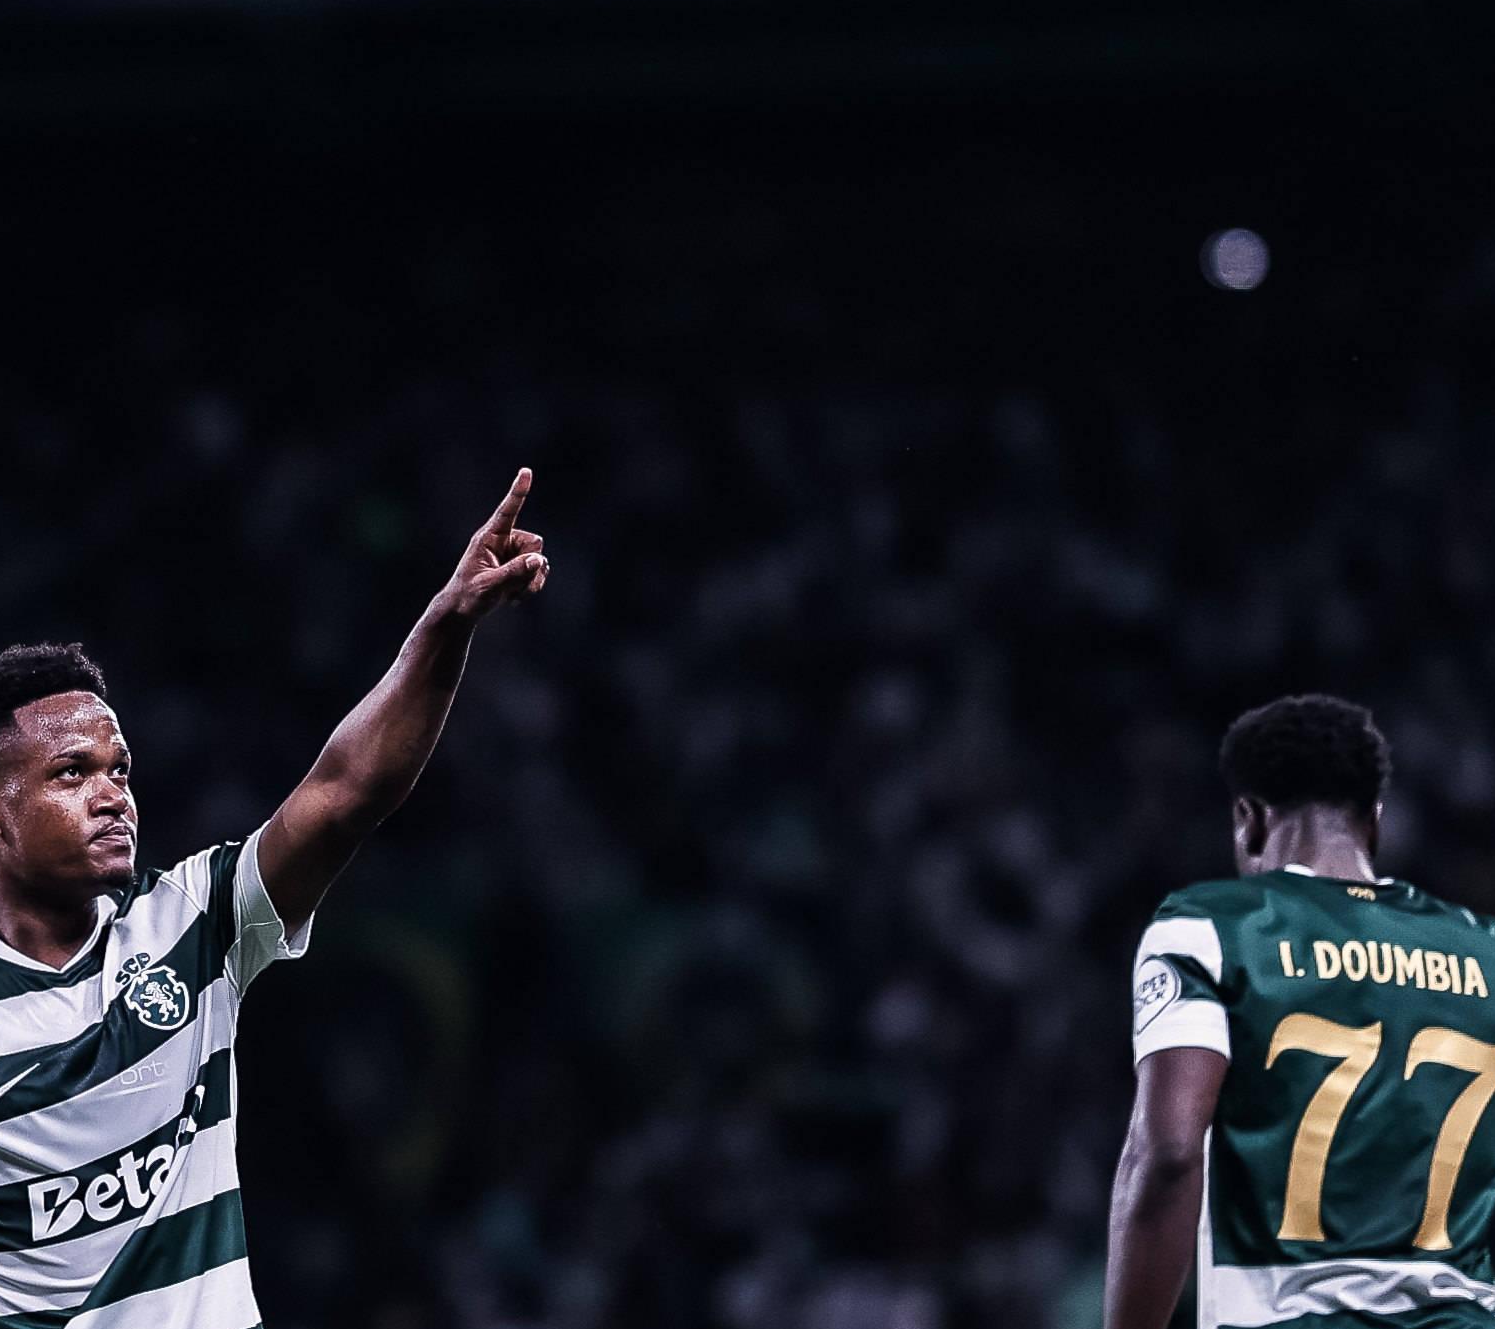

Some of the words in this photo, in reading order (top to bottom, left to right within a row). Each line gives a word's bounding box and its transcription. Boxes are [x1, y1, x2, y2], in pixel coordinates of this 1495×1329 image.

[114, 951, 152, 986] SCP
[1279, 940, 1307, 979] I.
[1314, 940, 1490, 999] DOUMBIA
[28, 1112, 198, 1242] Beta
